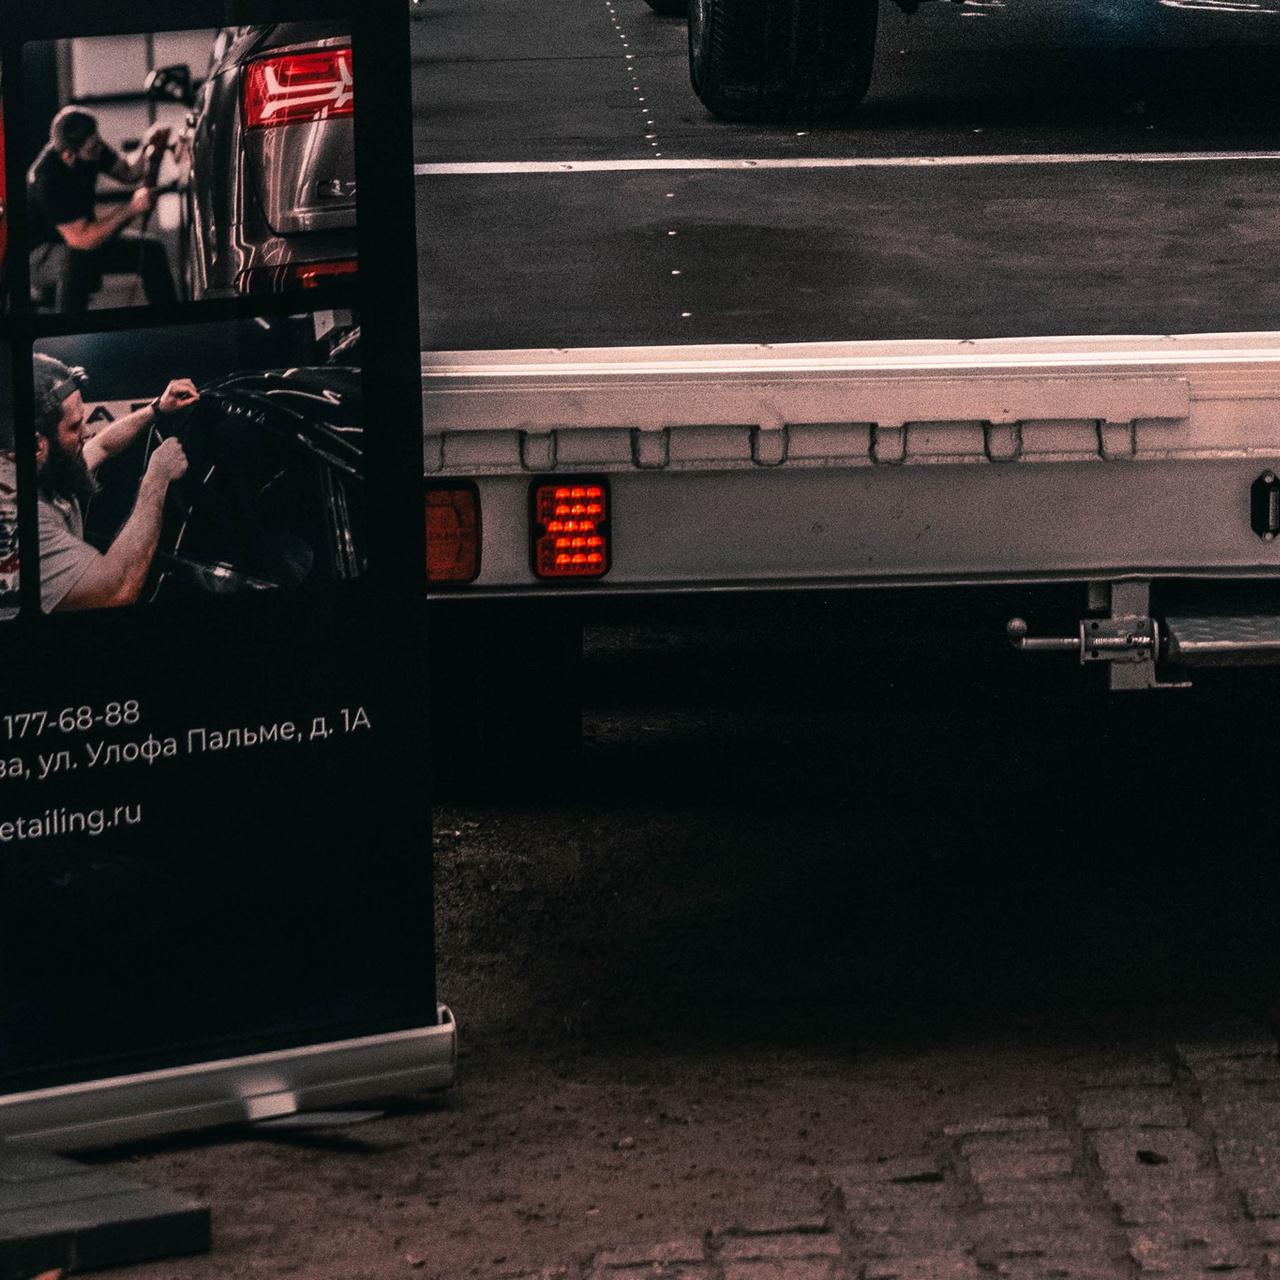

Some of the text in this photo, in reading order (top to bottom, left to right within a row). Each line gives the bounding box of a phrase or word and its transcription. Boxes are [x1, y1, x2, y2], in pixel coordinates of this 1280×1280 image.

[3, 699, 141, 740] 177-68-88
[38, 750, 78, 780] ул.
[86, 733, 178, 766] Улофа
[187, 721, 303, 754] Пальме,
[309, 716, 334, 741] д.
[340, 706, 372, 733] 1А
[0, 803, 142, 841] etailing.ru
